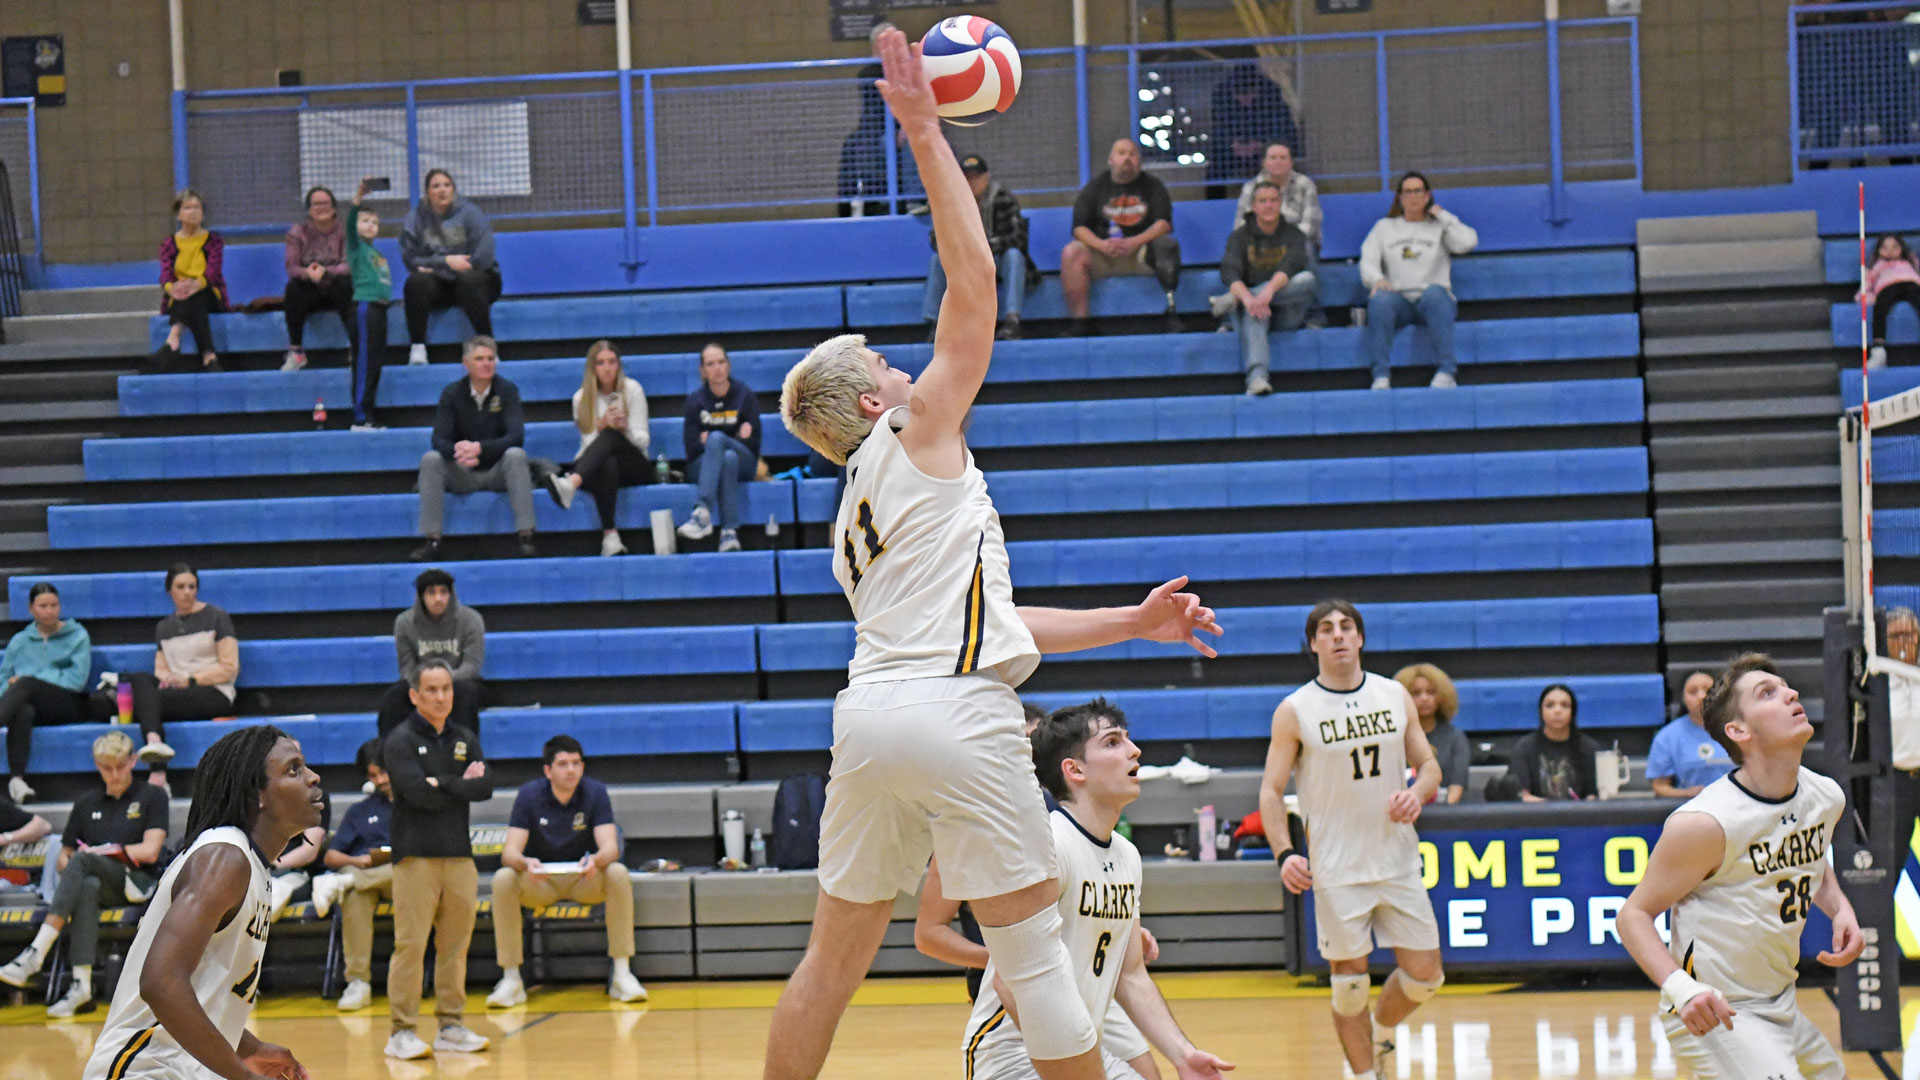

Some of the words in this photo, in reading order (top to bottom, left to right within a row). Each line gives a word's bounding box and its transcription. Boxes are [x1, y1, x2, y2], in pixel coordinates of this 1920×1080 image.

[1319, 710, 1397, 745] CLARKE
[1350, 744, 1381, 780] 17
[1748, 822, 1825, 875] CLARKE
[1776, 874, 1812, 924] 28
[1092, 928, 1112, 978] 6
